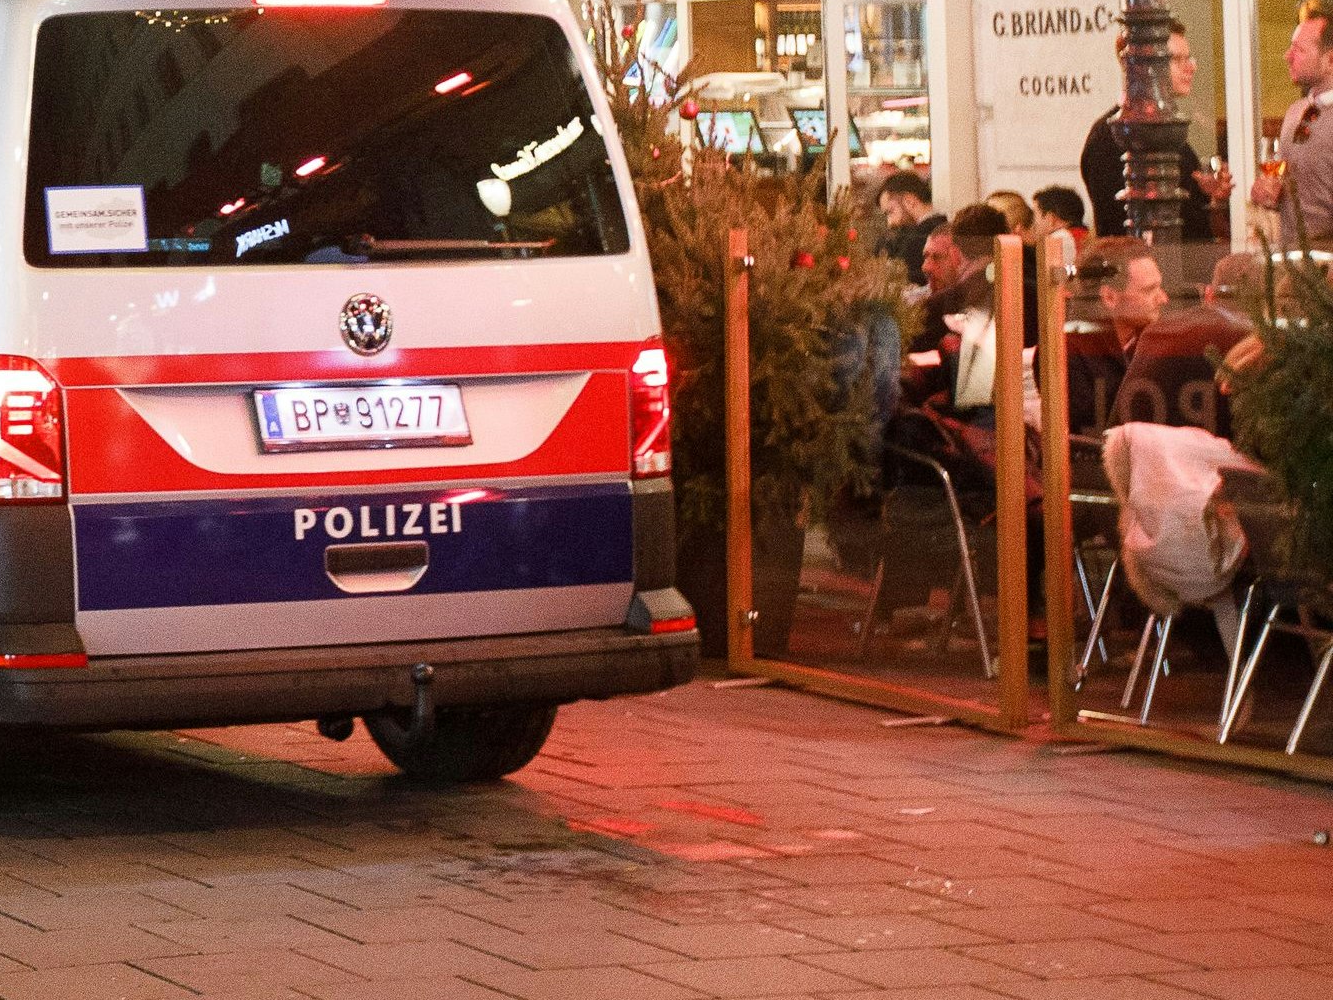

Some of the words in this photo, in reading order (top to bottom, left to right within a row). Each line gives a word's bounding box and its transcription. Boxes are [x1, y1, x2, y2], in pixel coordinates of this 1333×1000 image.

[1019, 73, 1092, 97] COGNAC
[292, 398, 329, 432] BP
[355, 395, 443, 430] 91277
[294, 502, 463, 541] POLIZEI
